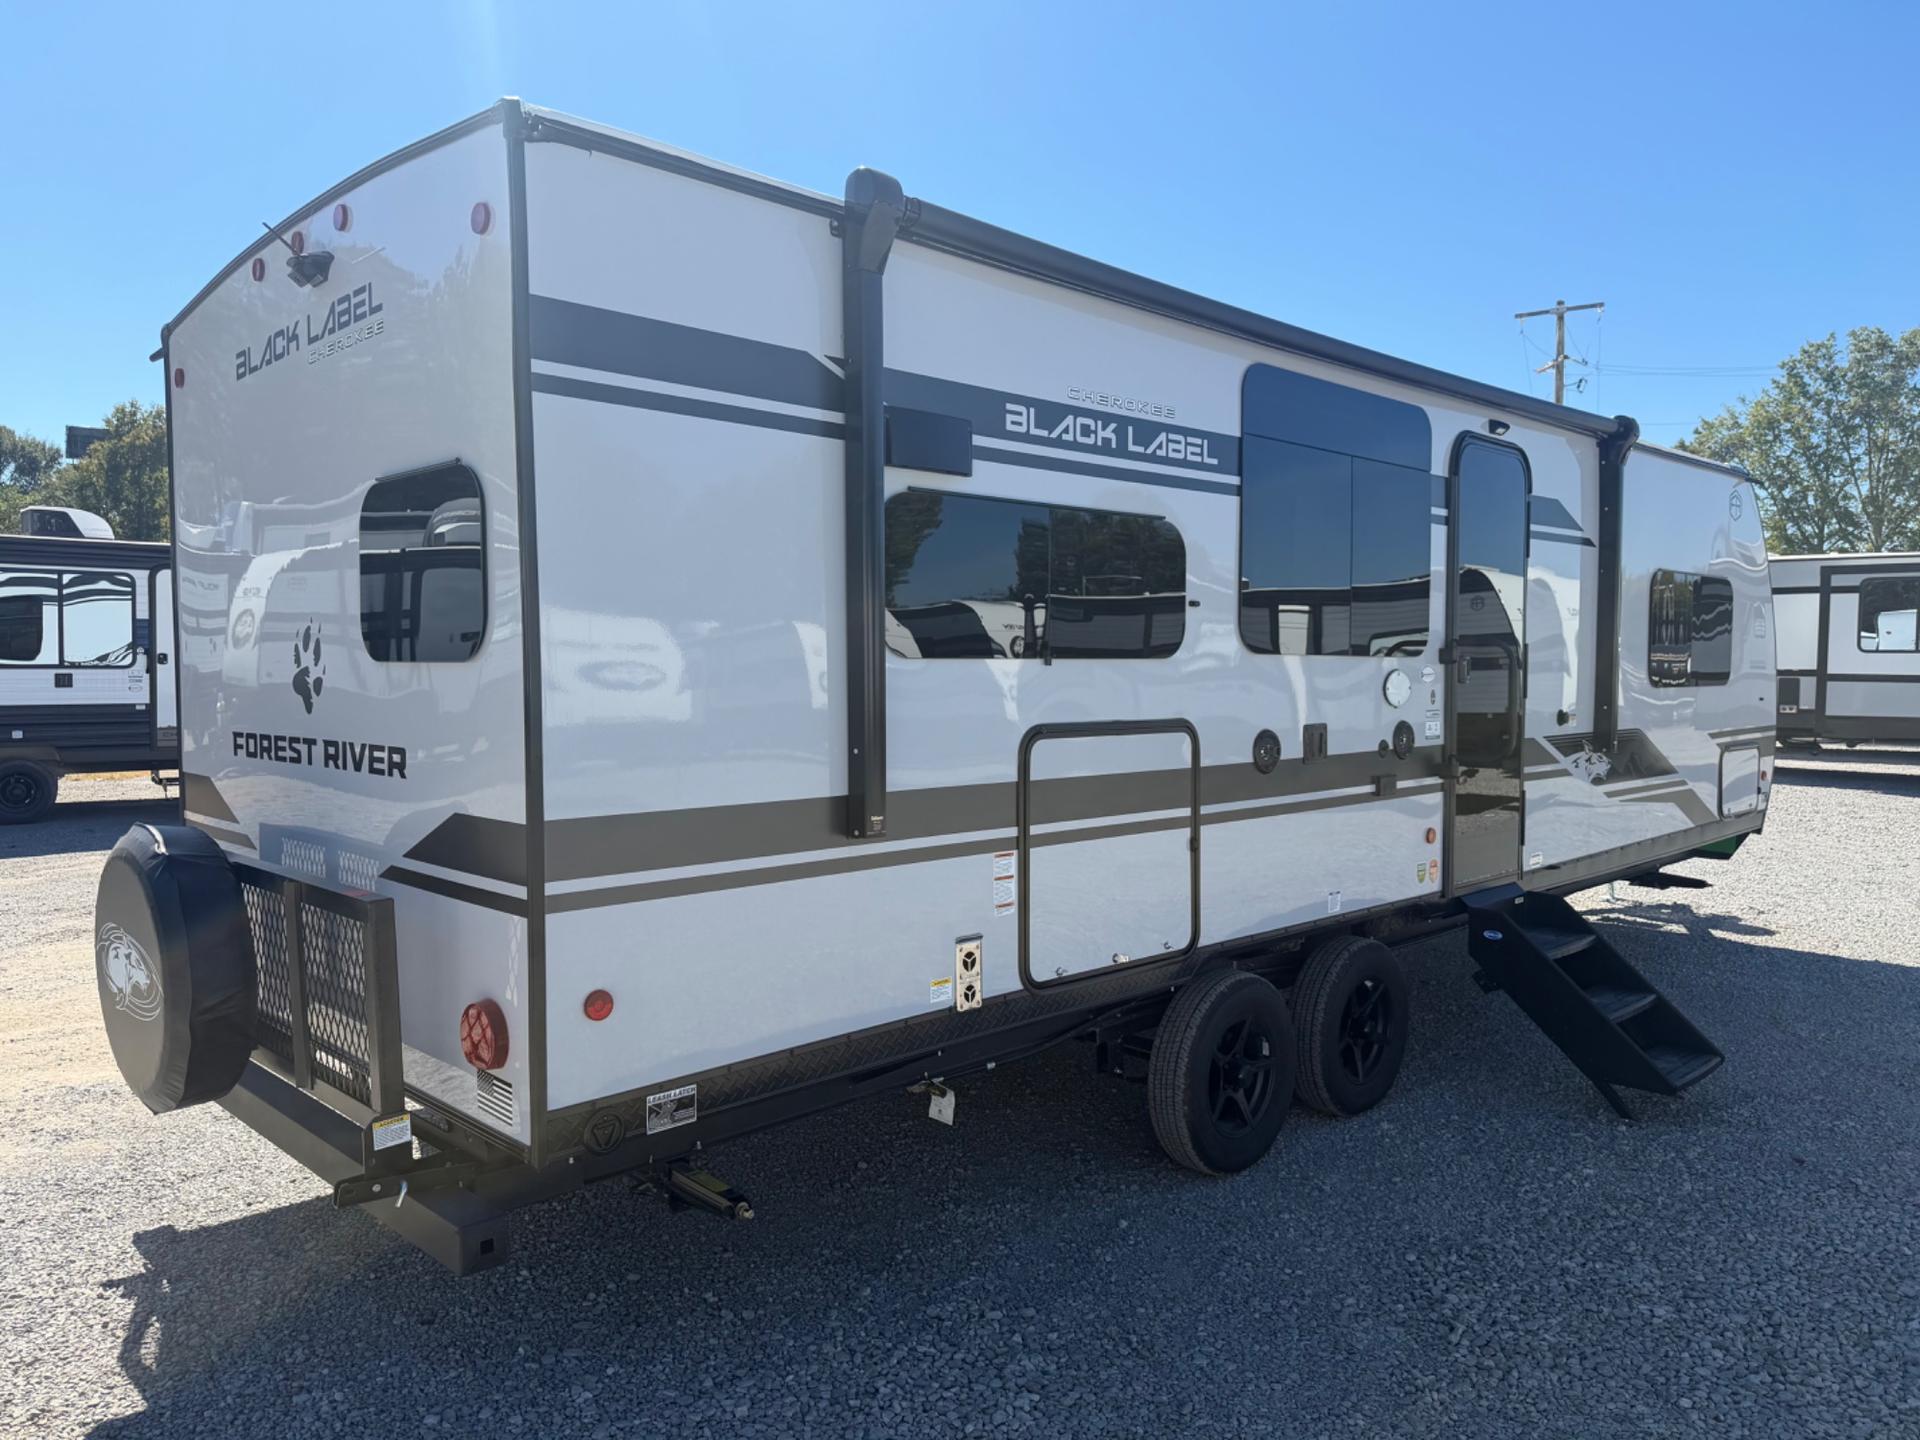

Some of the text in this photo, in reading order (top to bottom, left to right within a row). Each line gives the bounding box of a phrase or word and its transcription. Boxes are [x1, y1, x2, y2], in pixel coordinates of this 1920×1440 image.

[235, 281, 384, 381] BLACK LABEL
[307, 318, 385, 365] CHEROKEE
[1066, 386, 1177, 419] CHEROKEE
[1005, 402, 1219, 465] BLACK LABEL
[231, 730, 408, 780] FOREST RIVER
